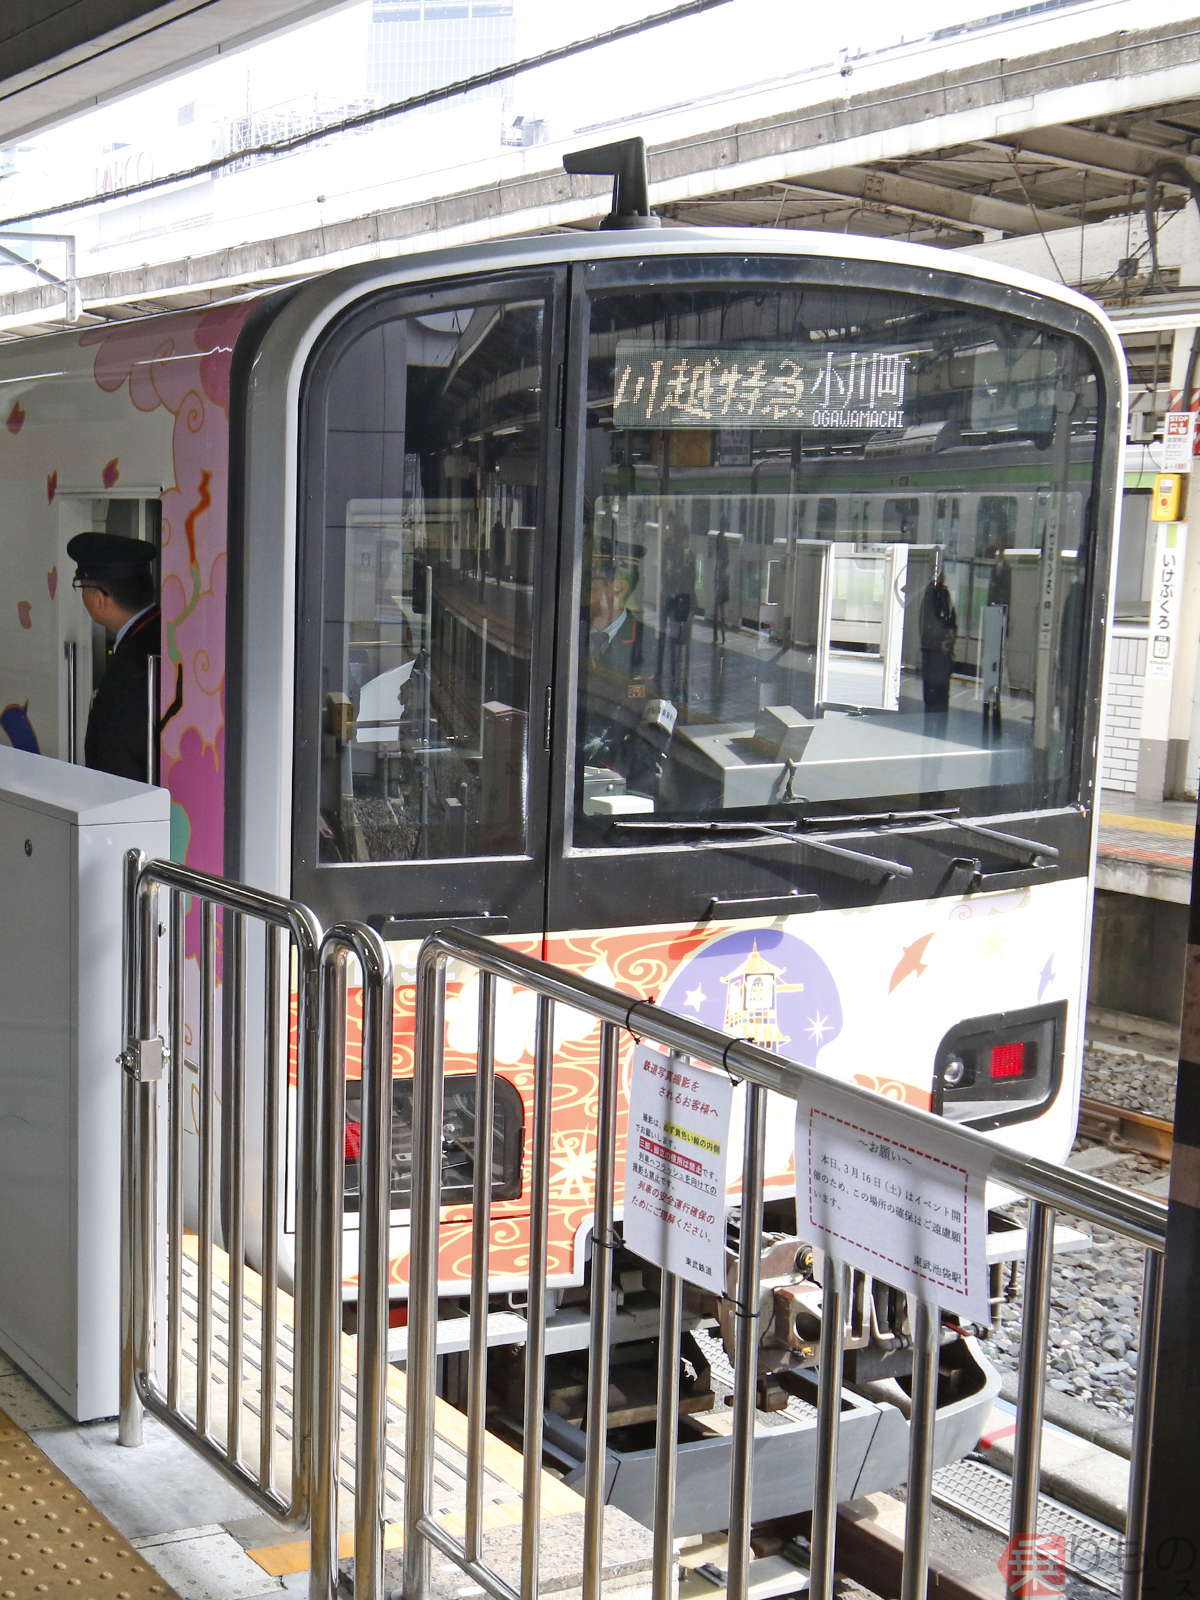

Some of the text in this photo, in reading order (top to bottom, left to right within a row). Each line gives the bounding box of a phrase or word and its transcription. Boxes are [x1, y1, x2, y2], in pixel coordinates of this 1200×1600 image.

[613, 351, 911, 420] 川越特急 小川町
[812, 410, 905, 428] OGAWAMACHI
[1157, 554, 1177, 630] いけぶくろ
